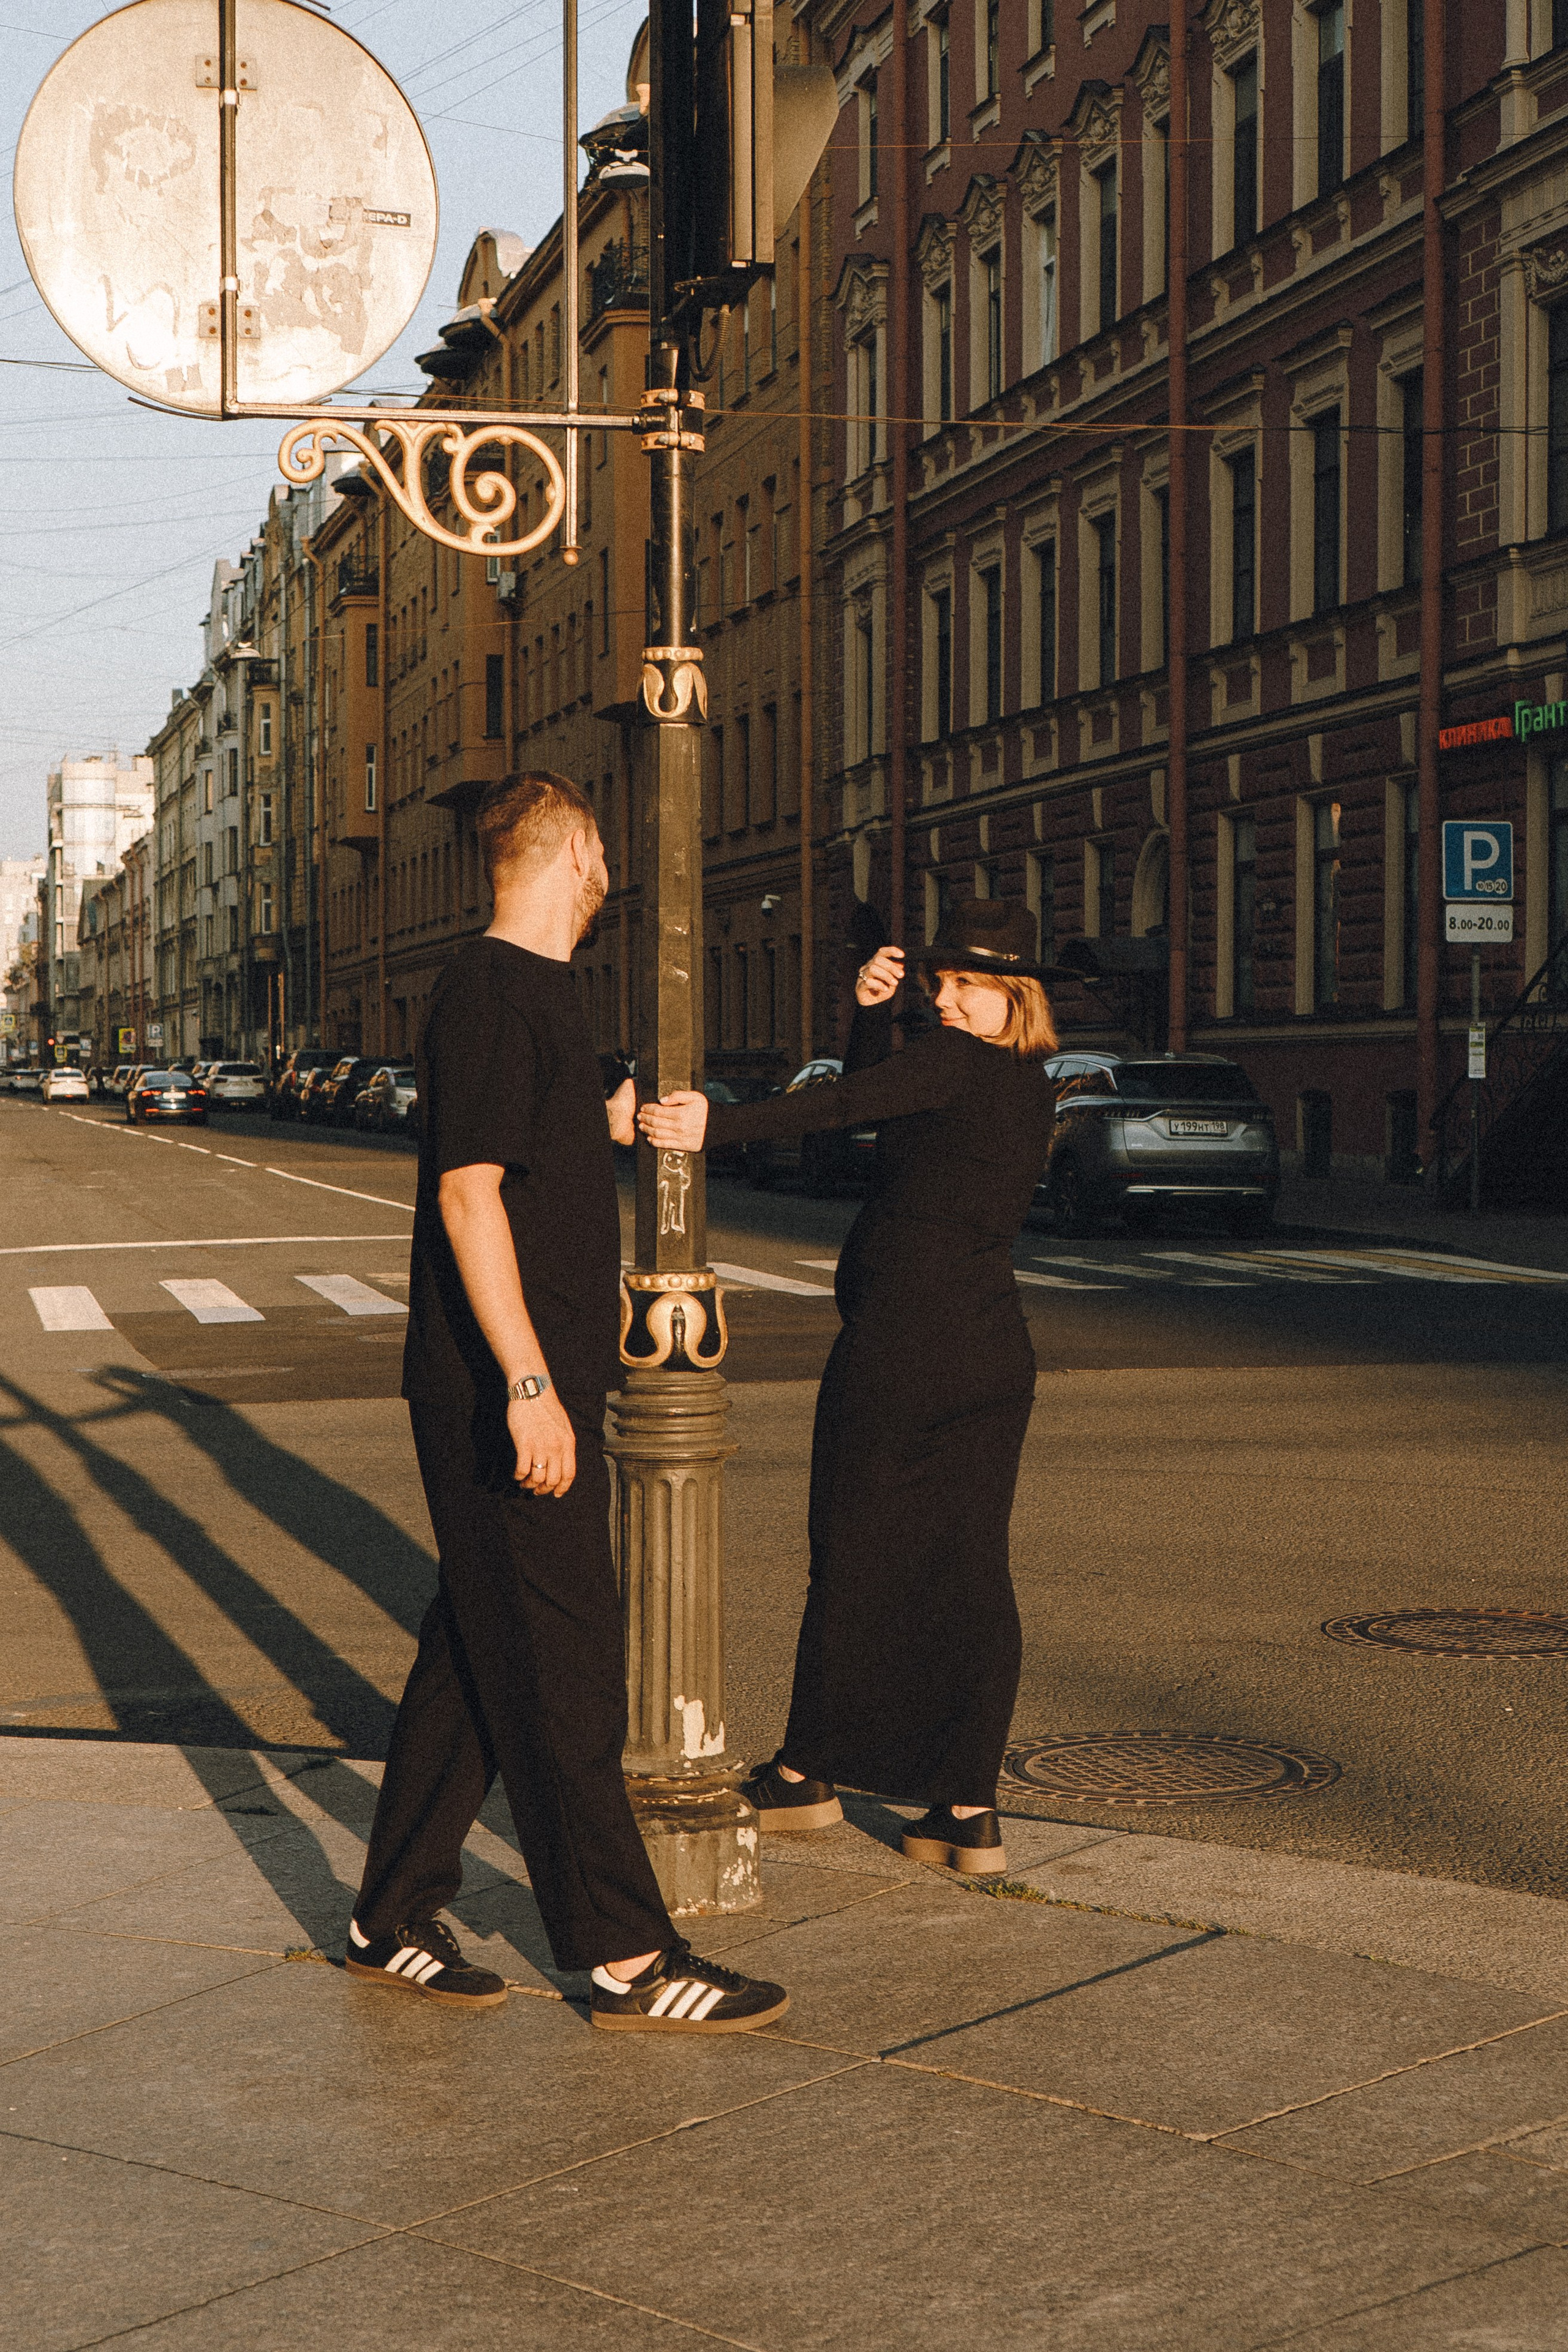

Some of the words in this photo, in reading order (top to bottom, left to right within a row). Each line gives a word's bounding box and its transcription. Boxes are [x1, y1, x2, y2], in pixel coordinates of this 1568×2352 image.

[1464, 831, 1499, 890] P
[1496, 882, 1507, 891] 20
[1449, 917, 1509, 930] 8.00-20.00
